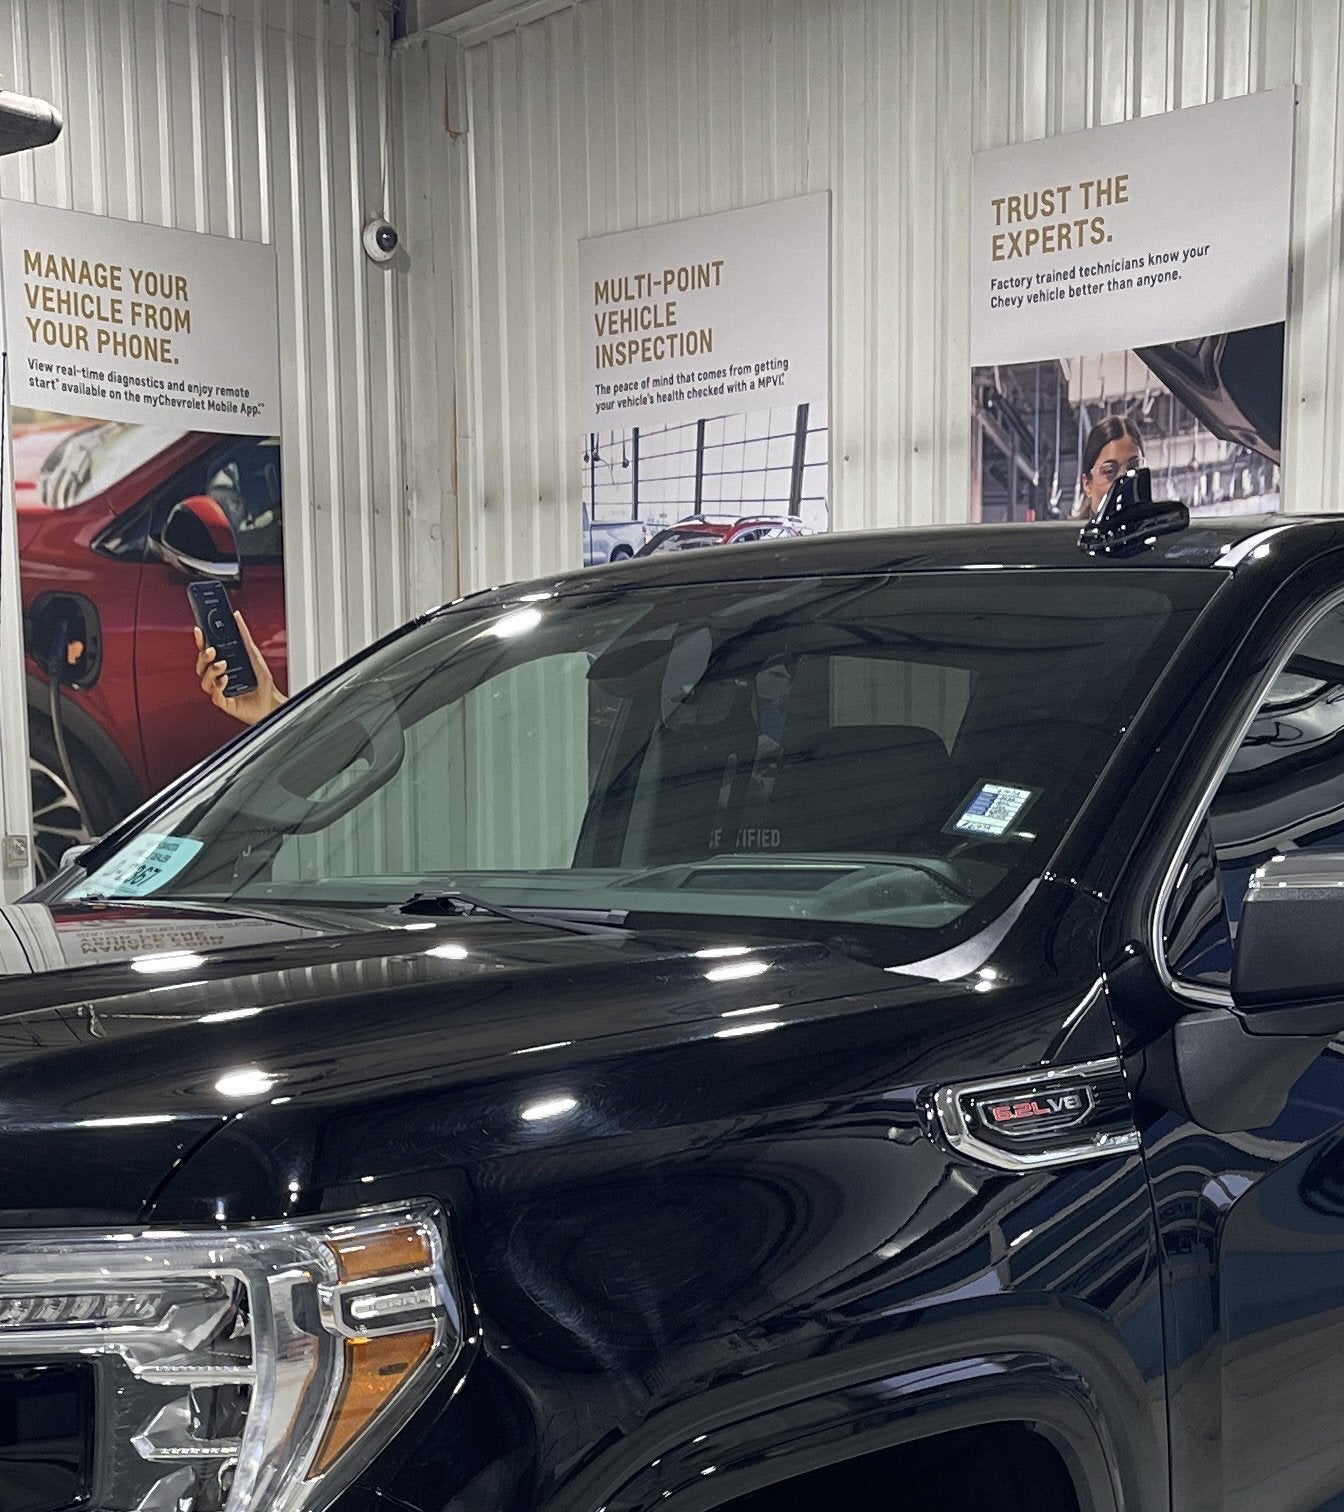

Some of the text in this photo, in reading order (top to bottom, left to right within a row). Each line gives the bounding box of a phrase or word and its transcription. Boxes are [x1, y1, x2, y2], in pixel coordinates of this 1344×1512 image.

[991, 174, 1128, 226] TRUST THE
[991, 216, 1112, 261] EXPERTS.
[23, 249, 189, 301] MANAGE YOUR
[594, 260, 724, 305] MULTI-POINT
[991, 244, 1210, 291] Factory trained technicians know your
[991, 269, 1182, 308] Chevy vehicle better than anyone.
[24, 283, 191, 334] VEHICLE FROM
[594, 301, 677, 336] VEHICLE
[26, 317, 180, 365] YOUR PHONE.
[595, 328, 713, 369] INSPECTION
[28, 358, 250, 399] View real-time diagnostics and enjoy remote
[61, 381, 106, 398] available
[109, 389, 121, 400] on
[124, 389, 141, 403] the
[143, 392, 205, 411] myChevrolet
[208, 399, 238, 414] Mobile
[595, 358, 789, 395] The peace of mind that comes from getting
[595, 399, 615, 414] your
[617, 393, 654, 409] vehicle's
[656, 388, 684, 403] health
[687, 383, 724, 400] checked
[726, 380, 747, 393] with
[749, 380, 755, 389] a
